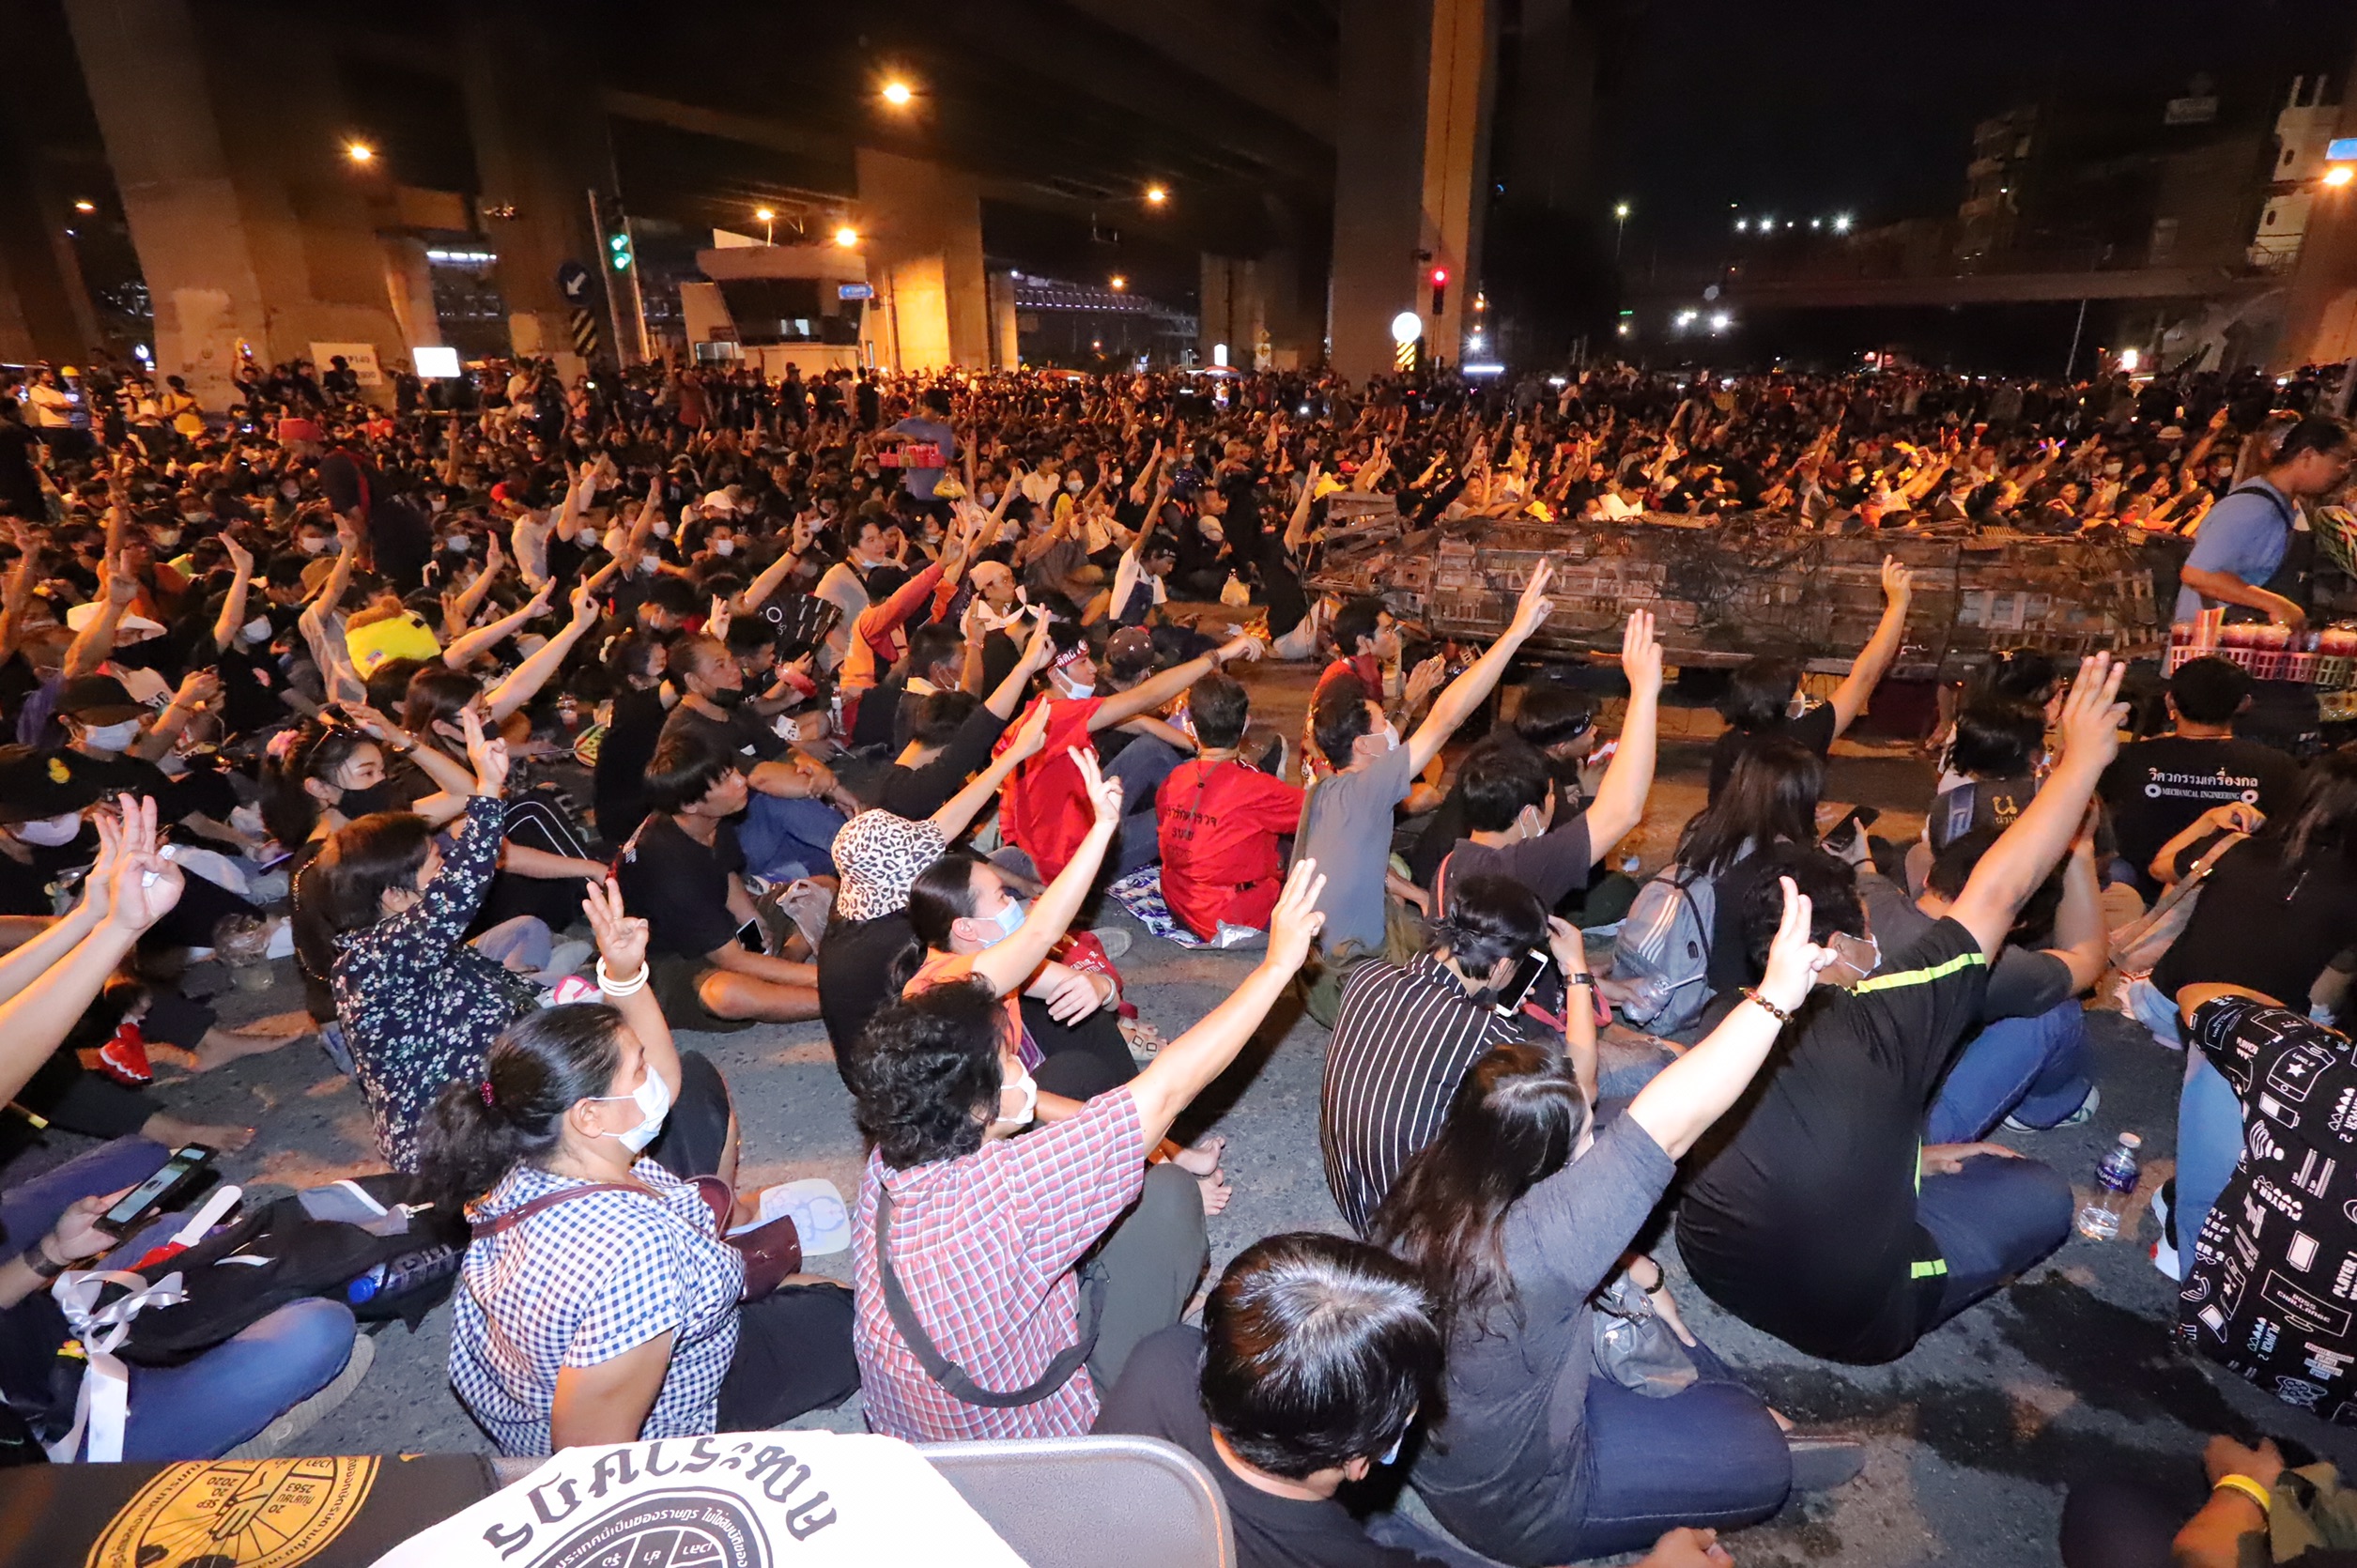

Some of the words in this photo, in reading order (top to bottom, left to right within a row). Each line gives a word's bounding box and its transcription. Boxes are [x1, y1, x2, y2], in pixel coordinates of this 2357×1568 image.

[2149, 767, 2258, 788] วิศวกรรมเครื่องกล
[2162, 787, 2199, 798] MECHANICAL
[207, 1476, 239, 1487] 2020
[285, 1483, 316, 1494] 2563
[195, 1499, 220, 1509] SEP
[276, 1493, 316, 1507] กันยายน
[483, 1437, 838, 1562] คณะราษฎร
[268, 1504, 286, 1514] 20
